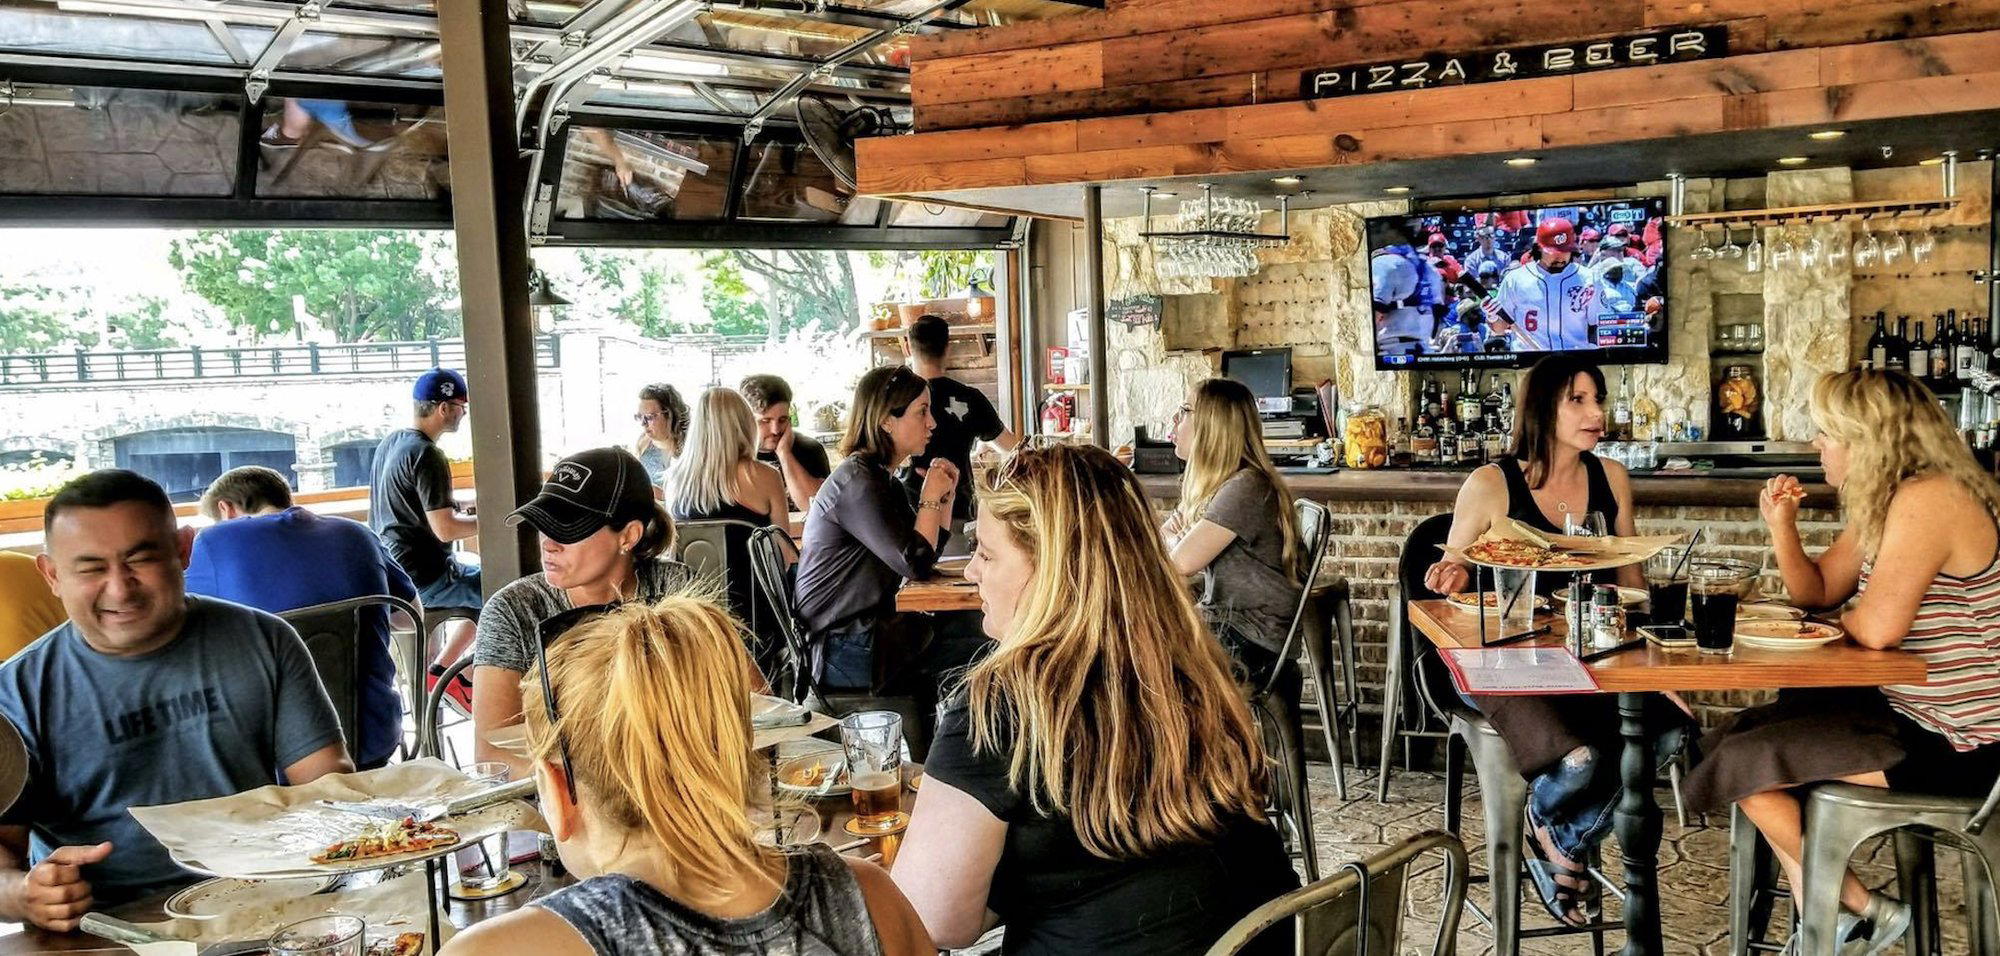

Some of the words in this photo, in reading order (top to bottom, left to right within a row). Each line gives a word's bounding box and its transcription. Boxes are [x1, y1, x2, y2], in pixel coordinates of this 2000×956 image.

[1313, 59, 1466, 94] PIZZA
[1493, 51, 1517, 76] &
[1543, 31, 1707, 71] BEER
[1524, 310, 1539, 332] 6
[104, 705, 157, 745] LIFE
[155, 687, 220, 726] TIME
